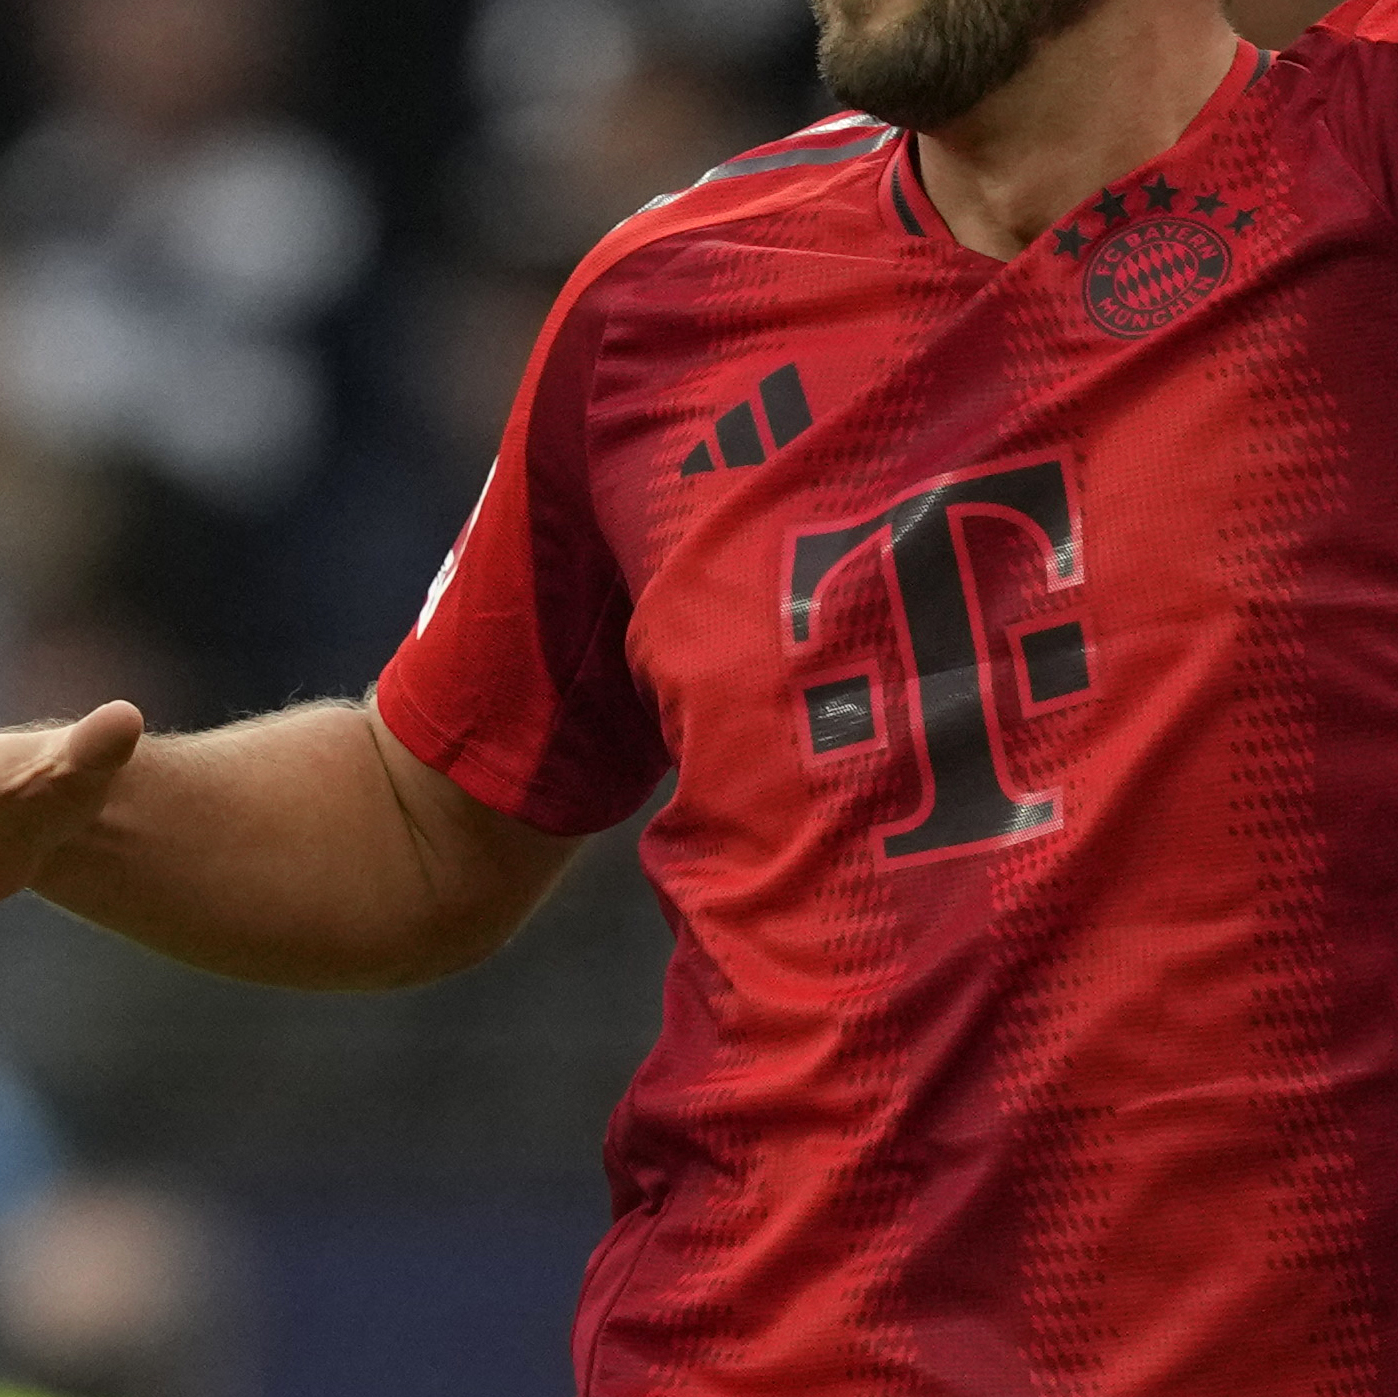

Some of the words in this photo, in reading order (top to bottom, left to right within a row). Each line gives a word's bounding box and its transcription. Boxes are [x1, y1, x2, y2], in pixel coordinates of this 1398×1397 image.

[1096, 248, 1122, 276] FC
[1125, 225, 1218, 259] BAYERN
[781, 444, 1085, 872] T
